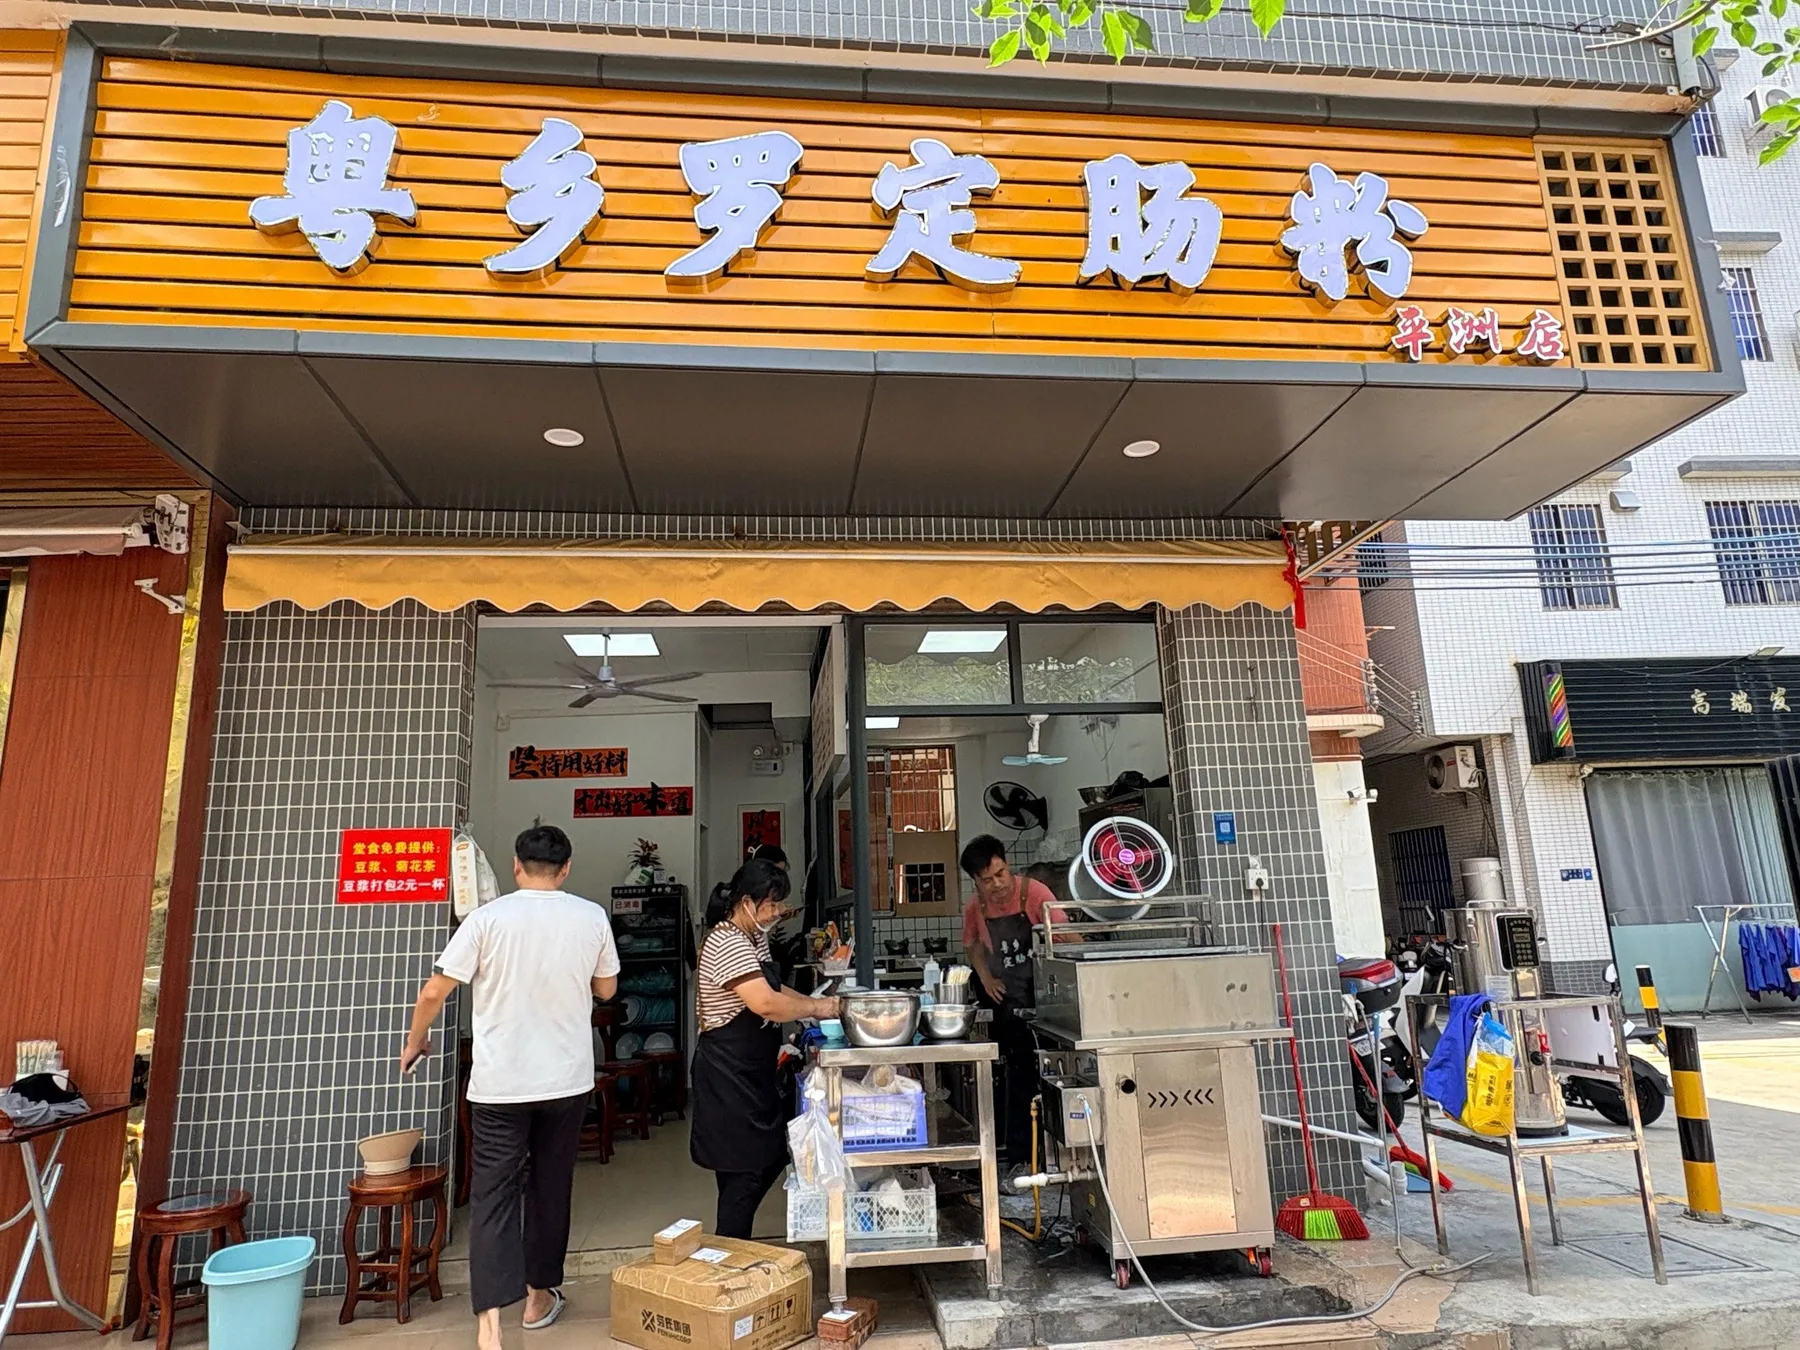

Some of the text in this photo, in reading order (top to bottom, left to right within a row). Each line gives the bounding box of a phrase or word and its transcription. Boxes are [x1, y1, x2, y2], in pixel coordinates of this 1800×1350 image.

[249, 100, 1428, 303] 粤乡罗定肠粉
[1391, 305, 1565, 361] 平洲店
[510, 745, 627, 778] 坚持用好料
[574, 781, 690, 816] 才出好味道
[341, 878, 446, 893] 豆浆打包2元一杯
